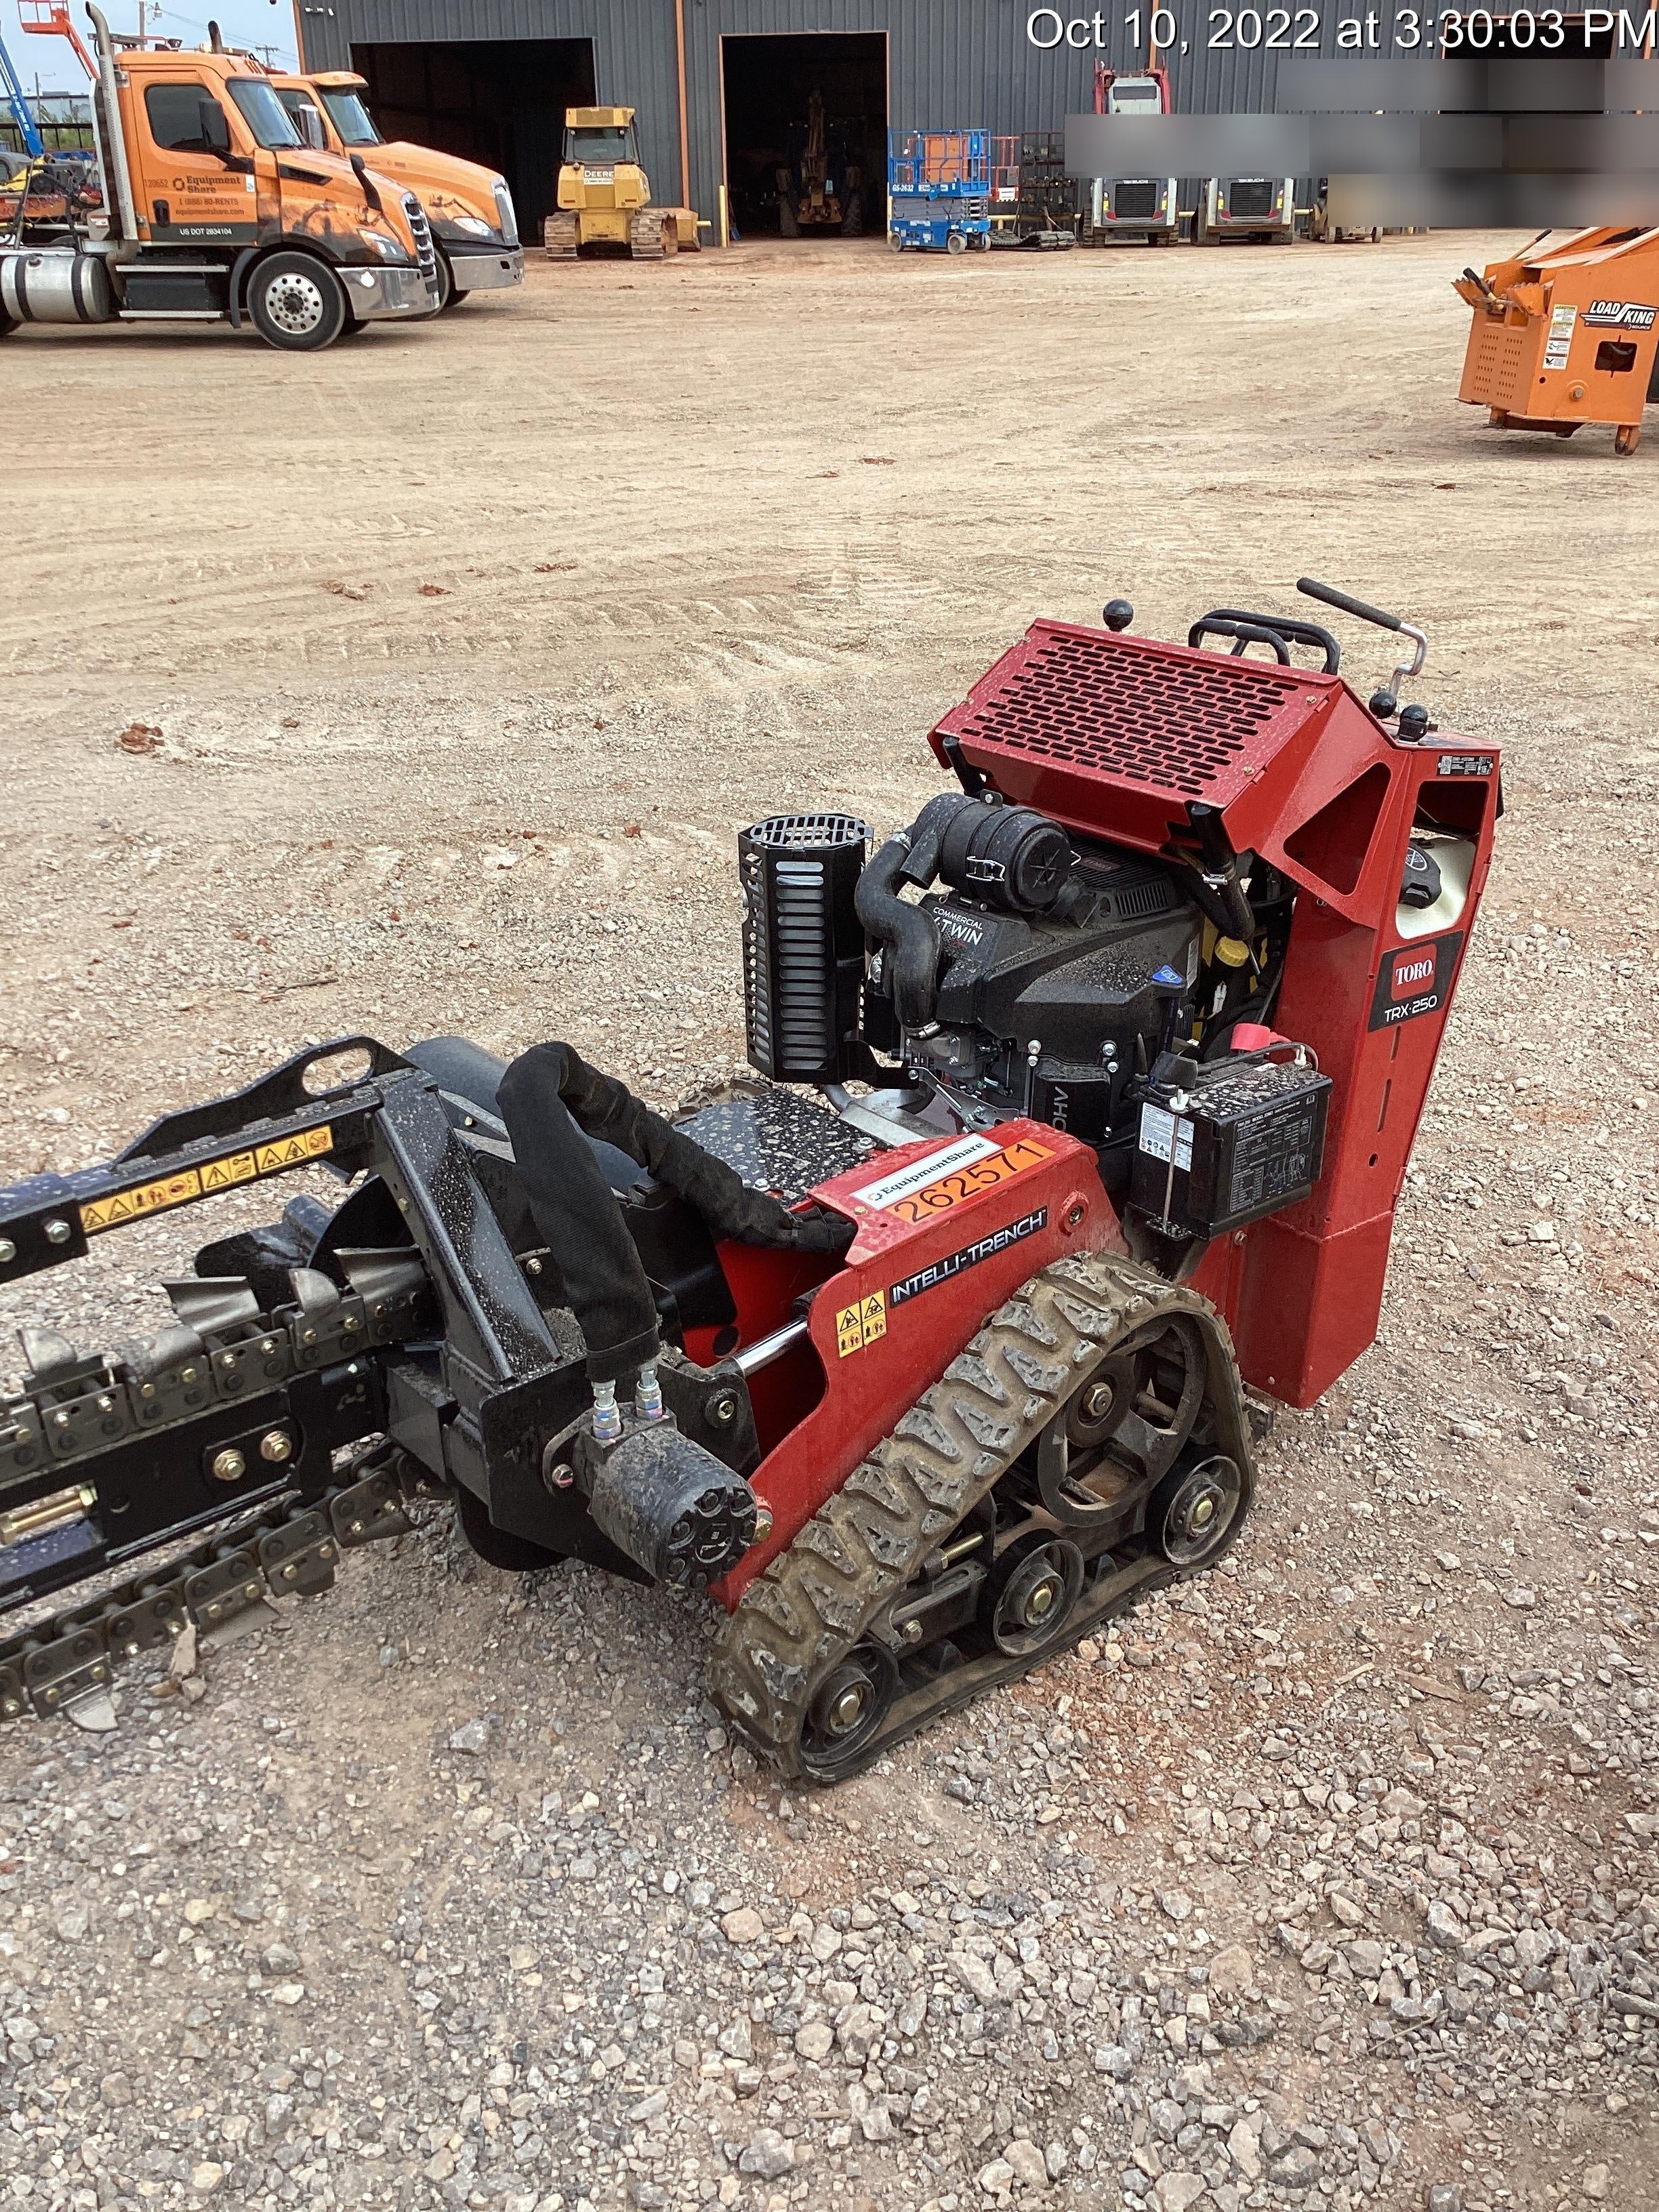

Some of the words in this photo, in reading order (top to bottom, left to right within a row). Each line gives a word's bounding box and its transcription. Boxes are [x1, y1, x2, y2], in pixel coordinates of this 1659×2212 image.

[186, 176, 241, 184] Equipment
[1589, 301, 1620, 314] LOAD
[1623, 311, 1655, 325] KING
[933, 907, 983, 930] COMMERCIAL
[1395, 959, 1433, 986] TORO
[1052, 1086, 1069, 1131] OHV
[882, 1143, 985, 1195] EquipmentShare
[894, 1143, 1044, 1223] 262571
